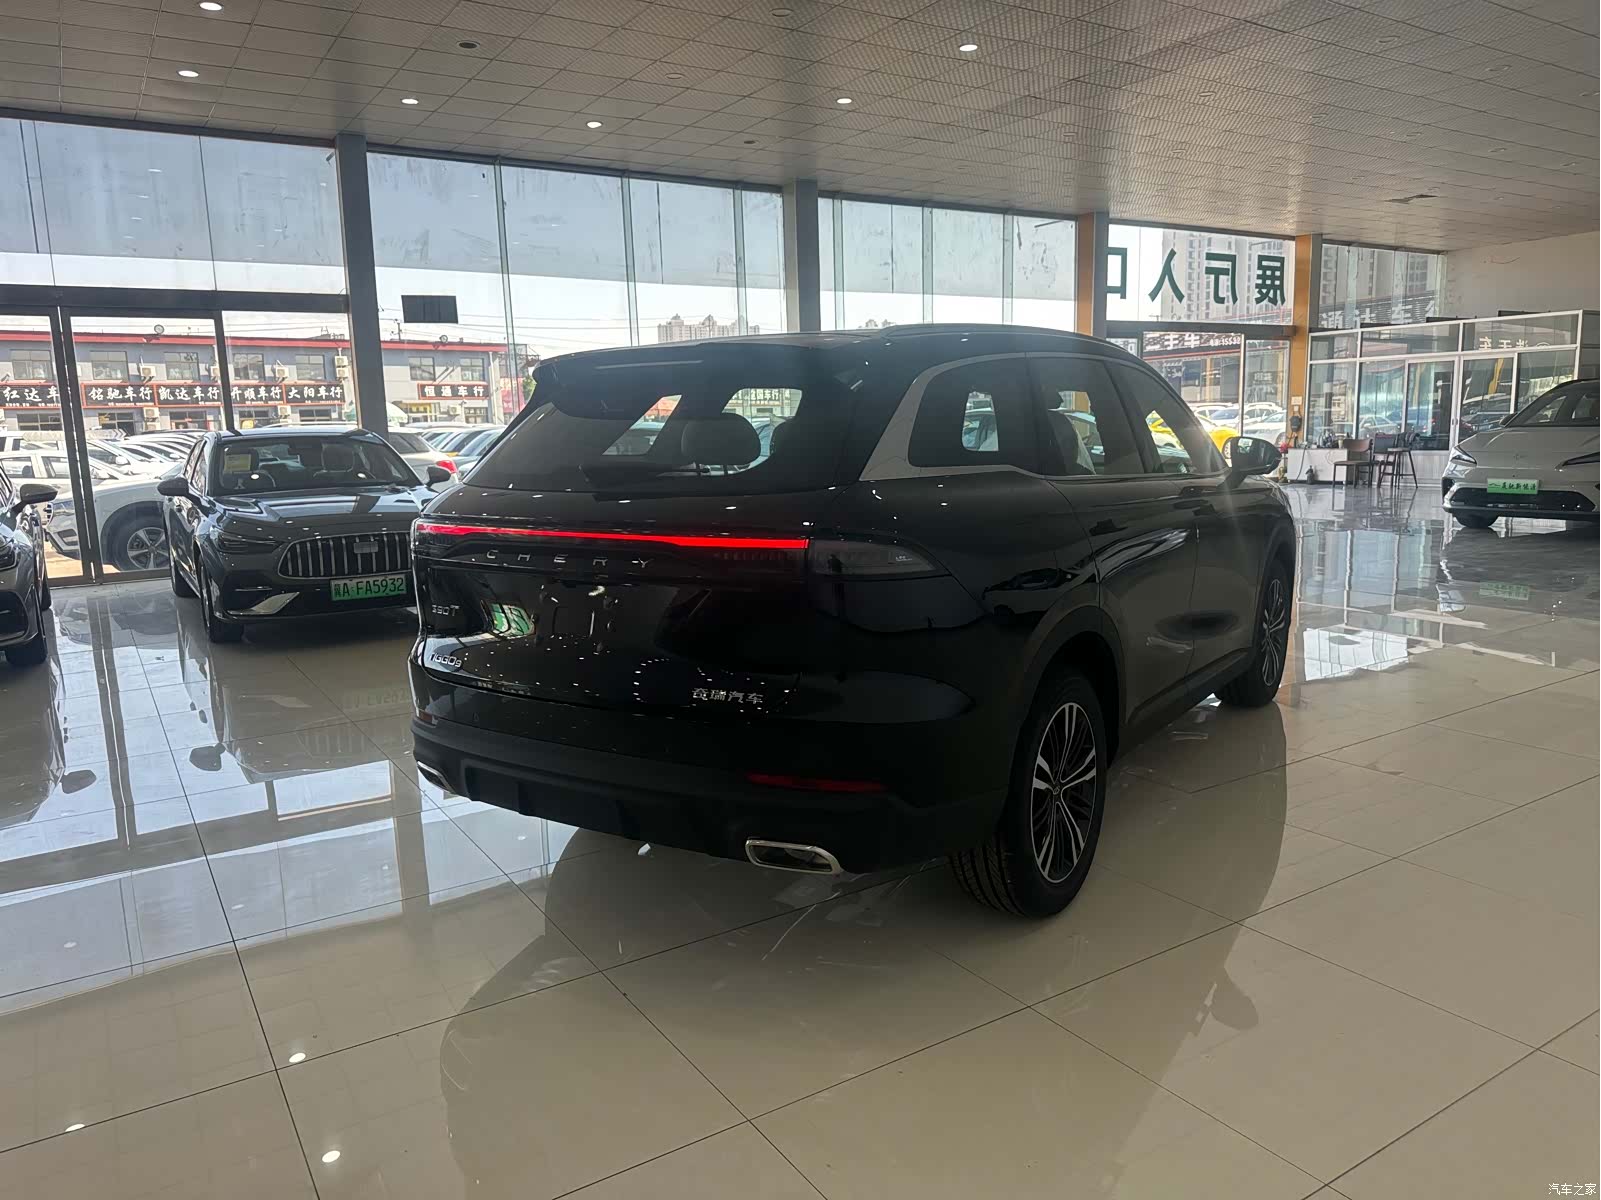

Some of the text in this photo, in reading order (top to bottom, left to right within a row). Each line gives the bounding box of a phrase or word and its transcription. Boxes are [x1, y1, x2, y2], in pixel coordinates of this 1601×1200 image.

[88, 387, 152, 402] 铭驰车行
[158, 386, 220, 401] 凯达车行
[287, 386, 343, 400] 大阳车行
[424, 385, 484, 397] 恒通车行
[486, 550, 653, 568] CHERY
[691, 687, 764, 704] 奇瑞汽车
